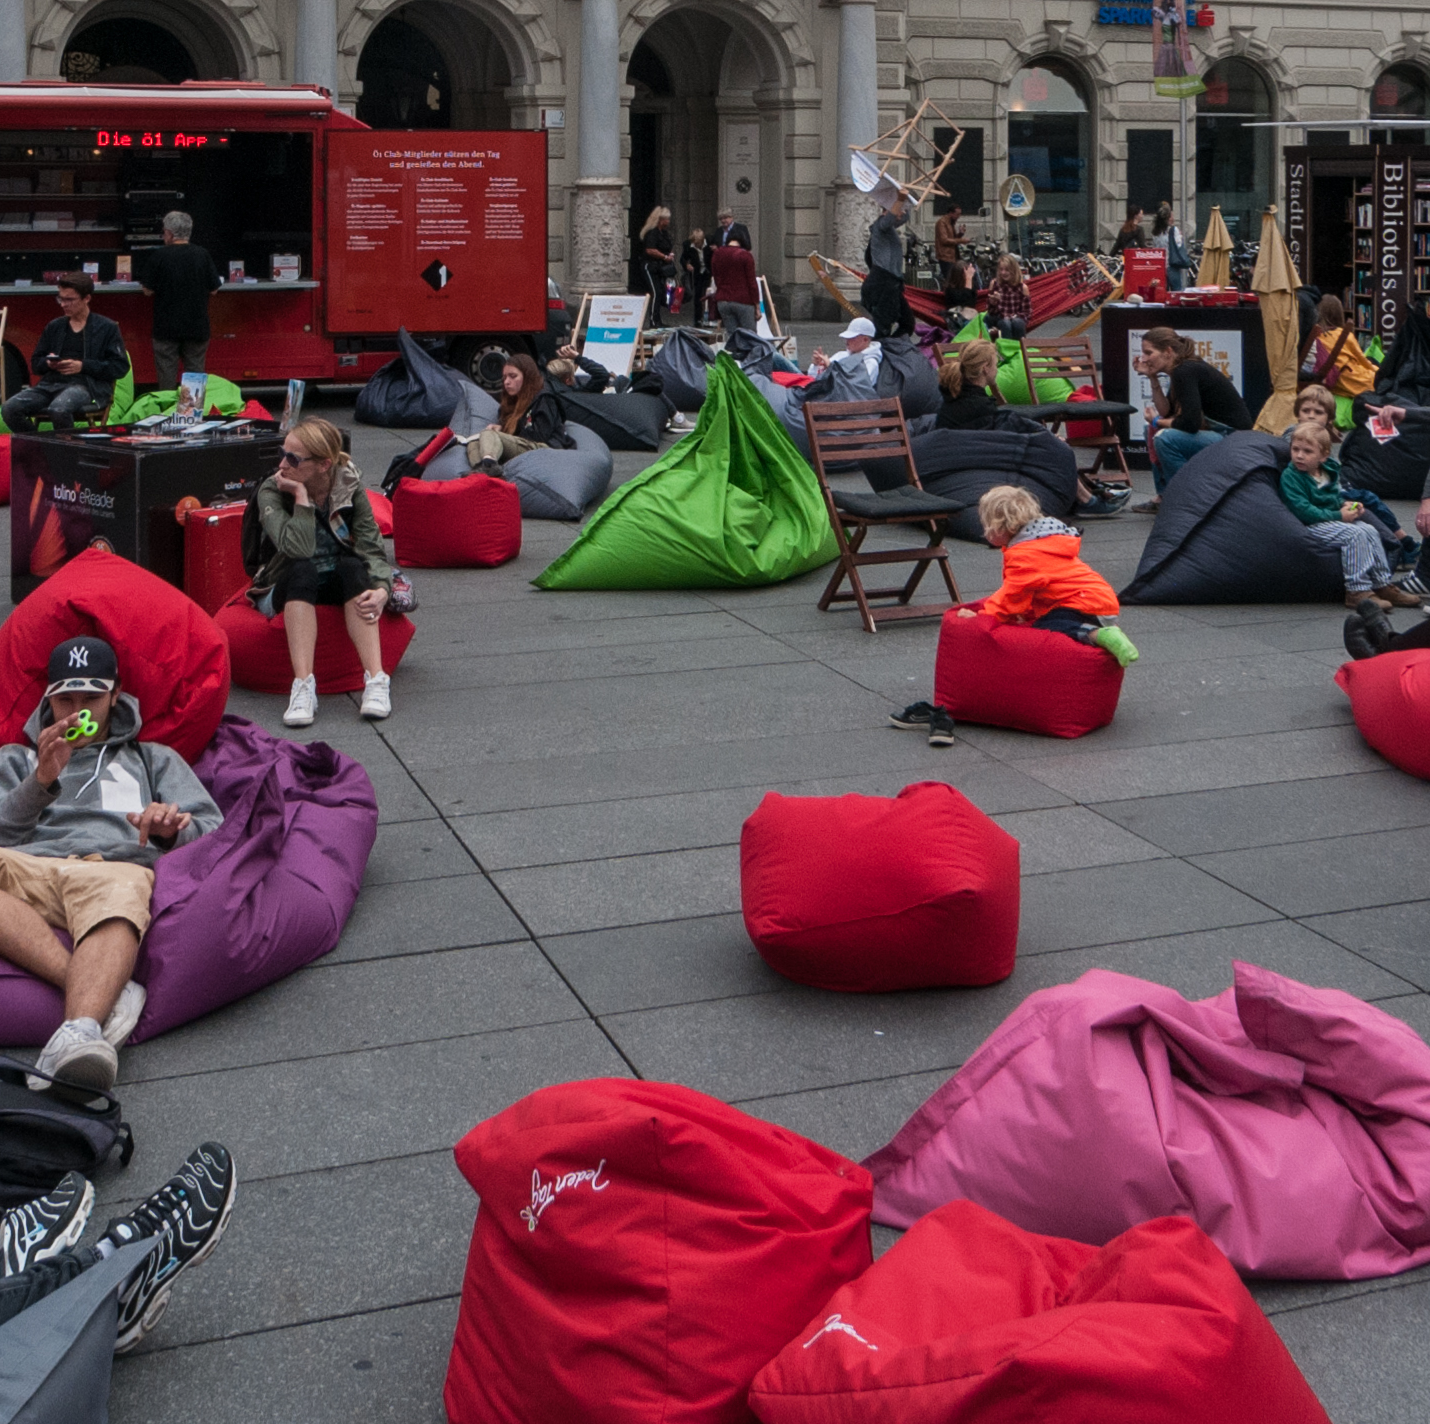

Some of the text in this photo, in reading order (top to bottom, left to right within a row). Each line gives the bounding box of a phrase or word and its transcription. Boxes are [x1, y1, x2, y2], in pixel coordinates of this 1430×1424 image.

[1099, 7, 1196, 25] SPARKE
[97, 131, 131, 146] Die
[174, 133, 207, 147] App
[384, 150, 442, 159] Club-Mitglieder
[487, 151, 500, 159] Tag
[54, 483, 76, 502] tolino
[80, 488, 115, 508] eReader
